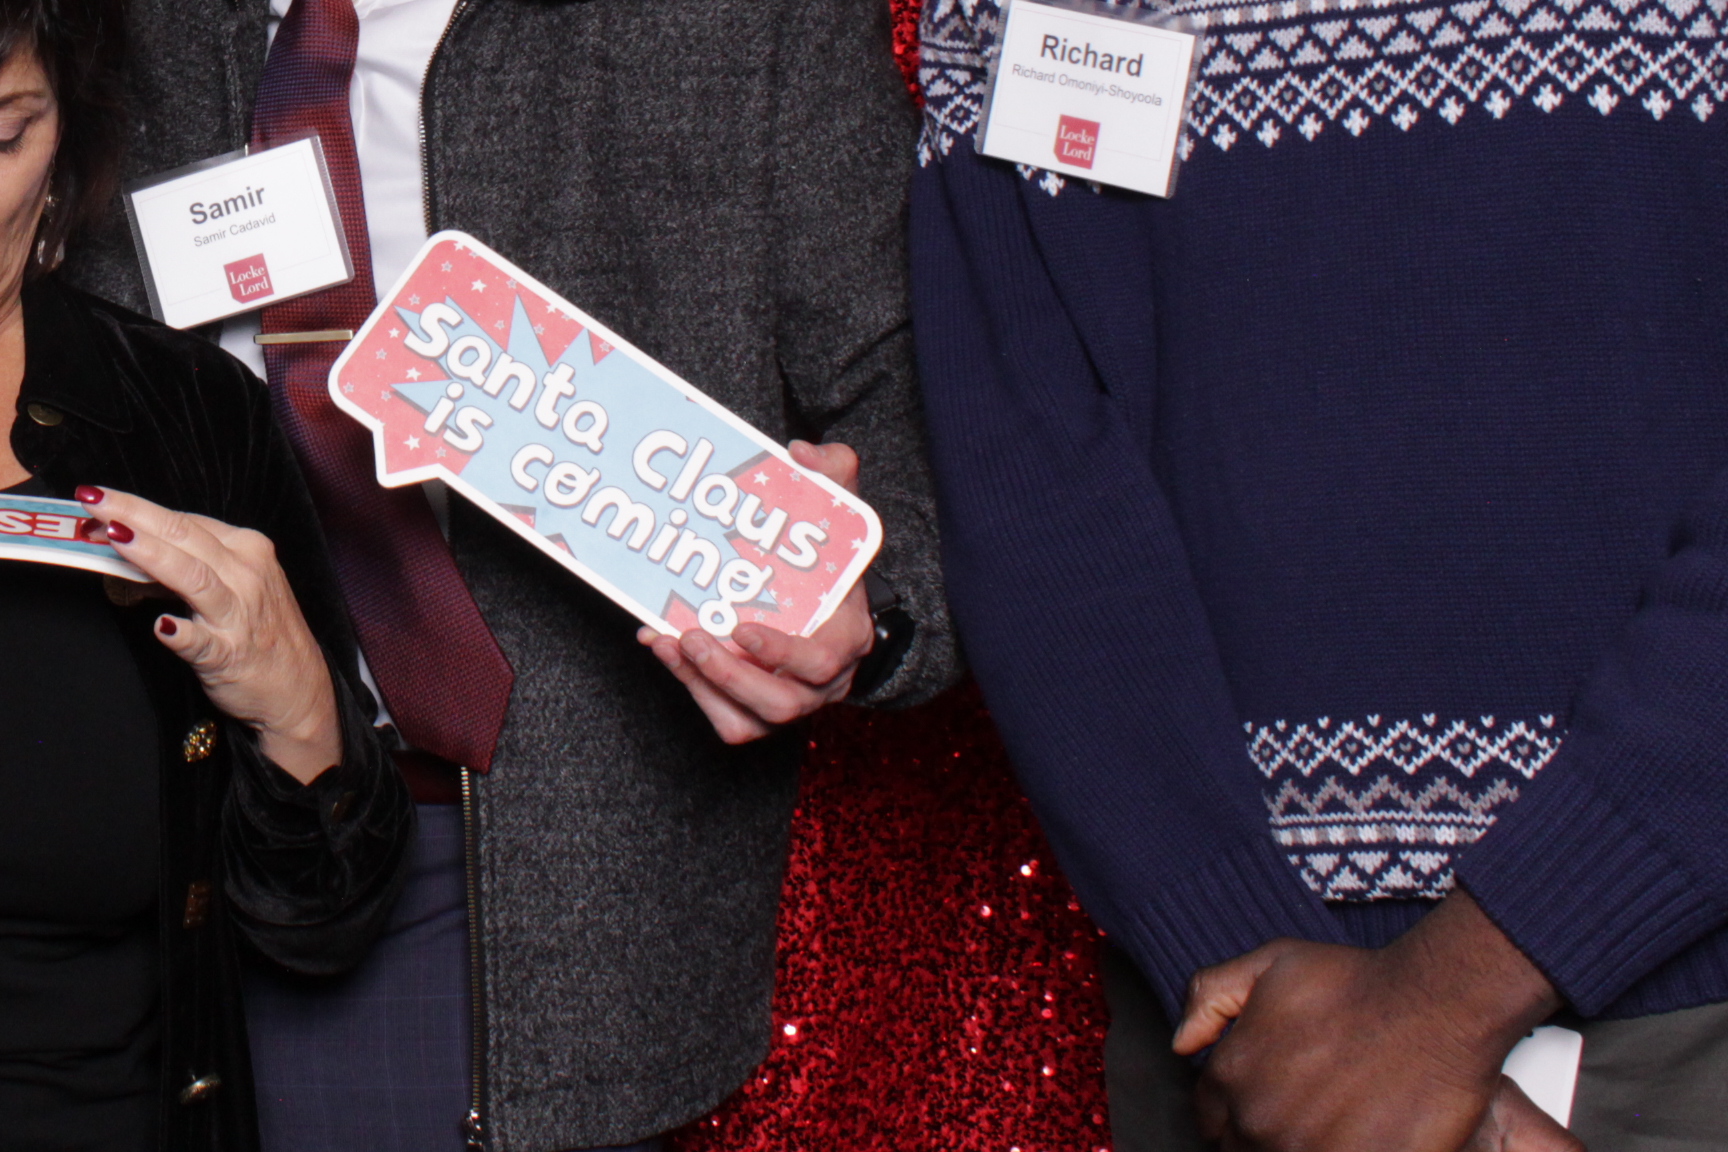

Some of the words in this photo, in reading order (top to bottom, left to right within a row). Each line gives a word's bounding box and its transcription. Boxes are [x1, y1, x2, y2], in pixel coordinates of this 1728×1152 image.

[1040, 34, 1144, 77] Richard
[1012, 63, 1056, 84] Richard
[1058, 73, 1163, 107] Omoniyi-Shoyoola
[1059, 124, 1095, 145] Locke
[1062, 142, 1093, 161] Lord
[189, 186, 265, 225] Samir
[193, 228, 227, 248] Samir
[229, 212, 276, 237] Cadavid
[229, 265, 266, 285] Locke
[239, 278, 270, 297] Lord
[404, 302, 610, 453] Santa
[632, 429, 830, 570] Claus
[423, 382, 494, 452] is
[510, 443, 774, 637] coming
